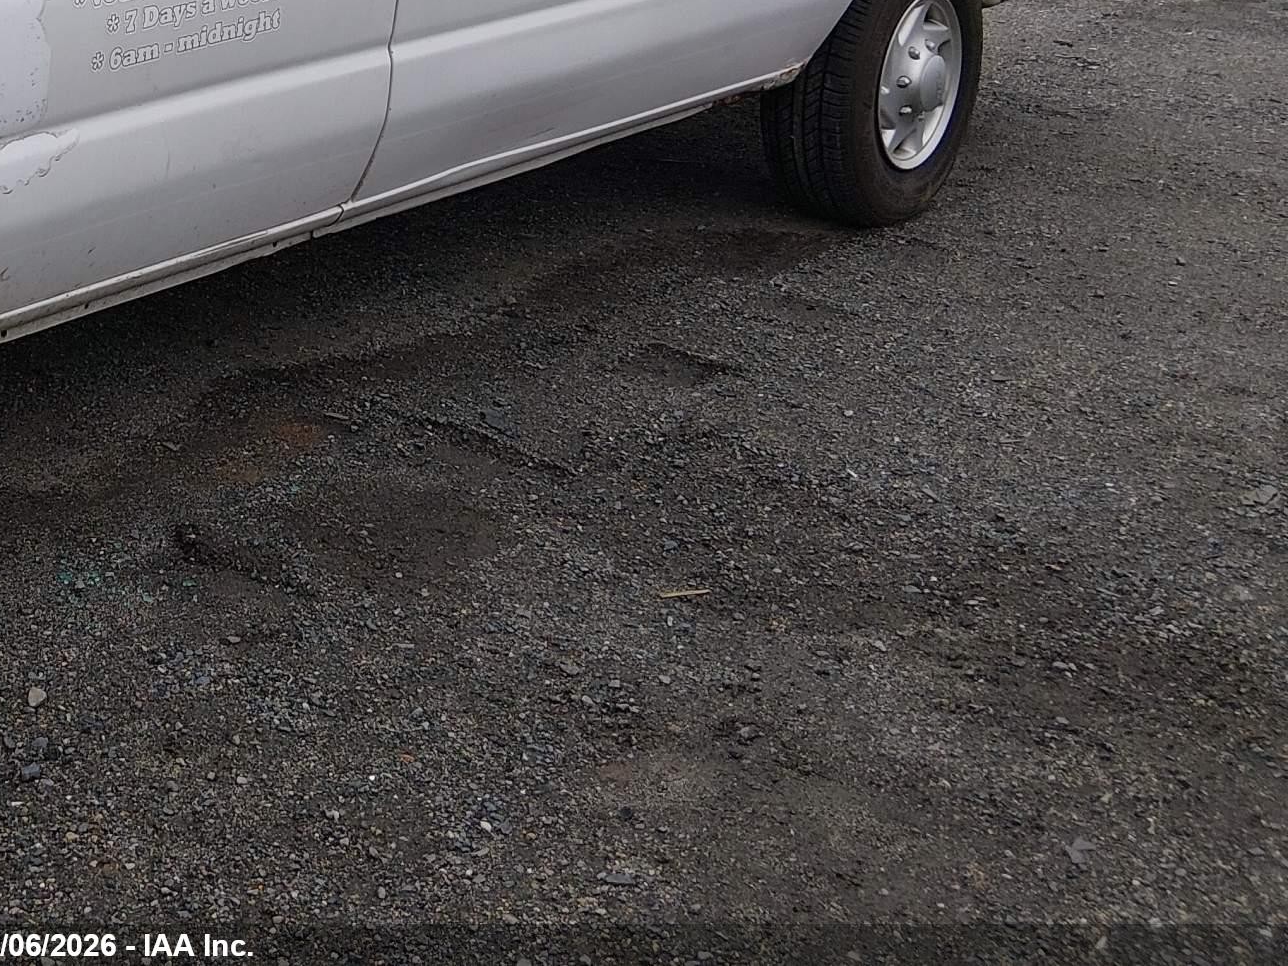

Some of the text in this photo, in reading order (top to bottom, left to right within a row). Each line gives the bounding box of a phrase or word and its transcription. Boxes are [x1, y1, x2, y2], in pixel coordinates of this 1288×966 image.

[109, 41, 159, 71] 6am
[163, 42, 174, 53] -
[176, 7, 281, 55] midnight
[124, 9, 138, 33] 7
[142, 0, 197, 29] Days
